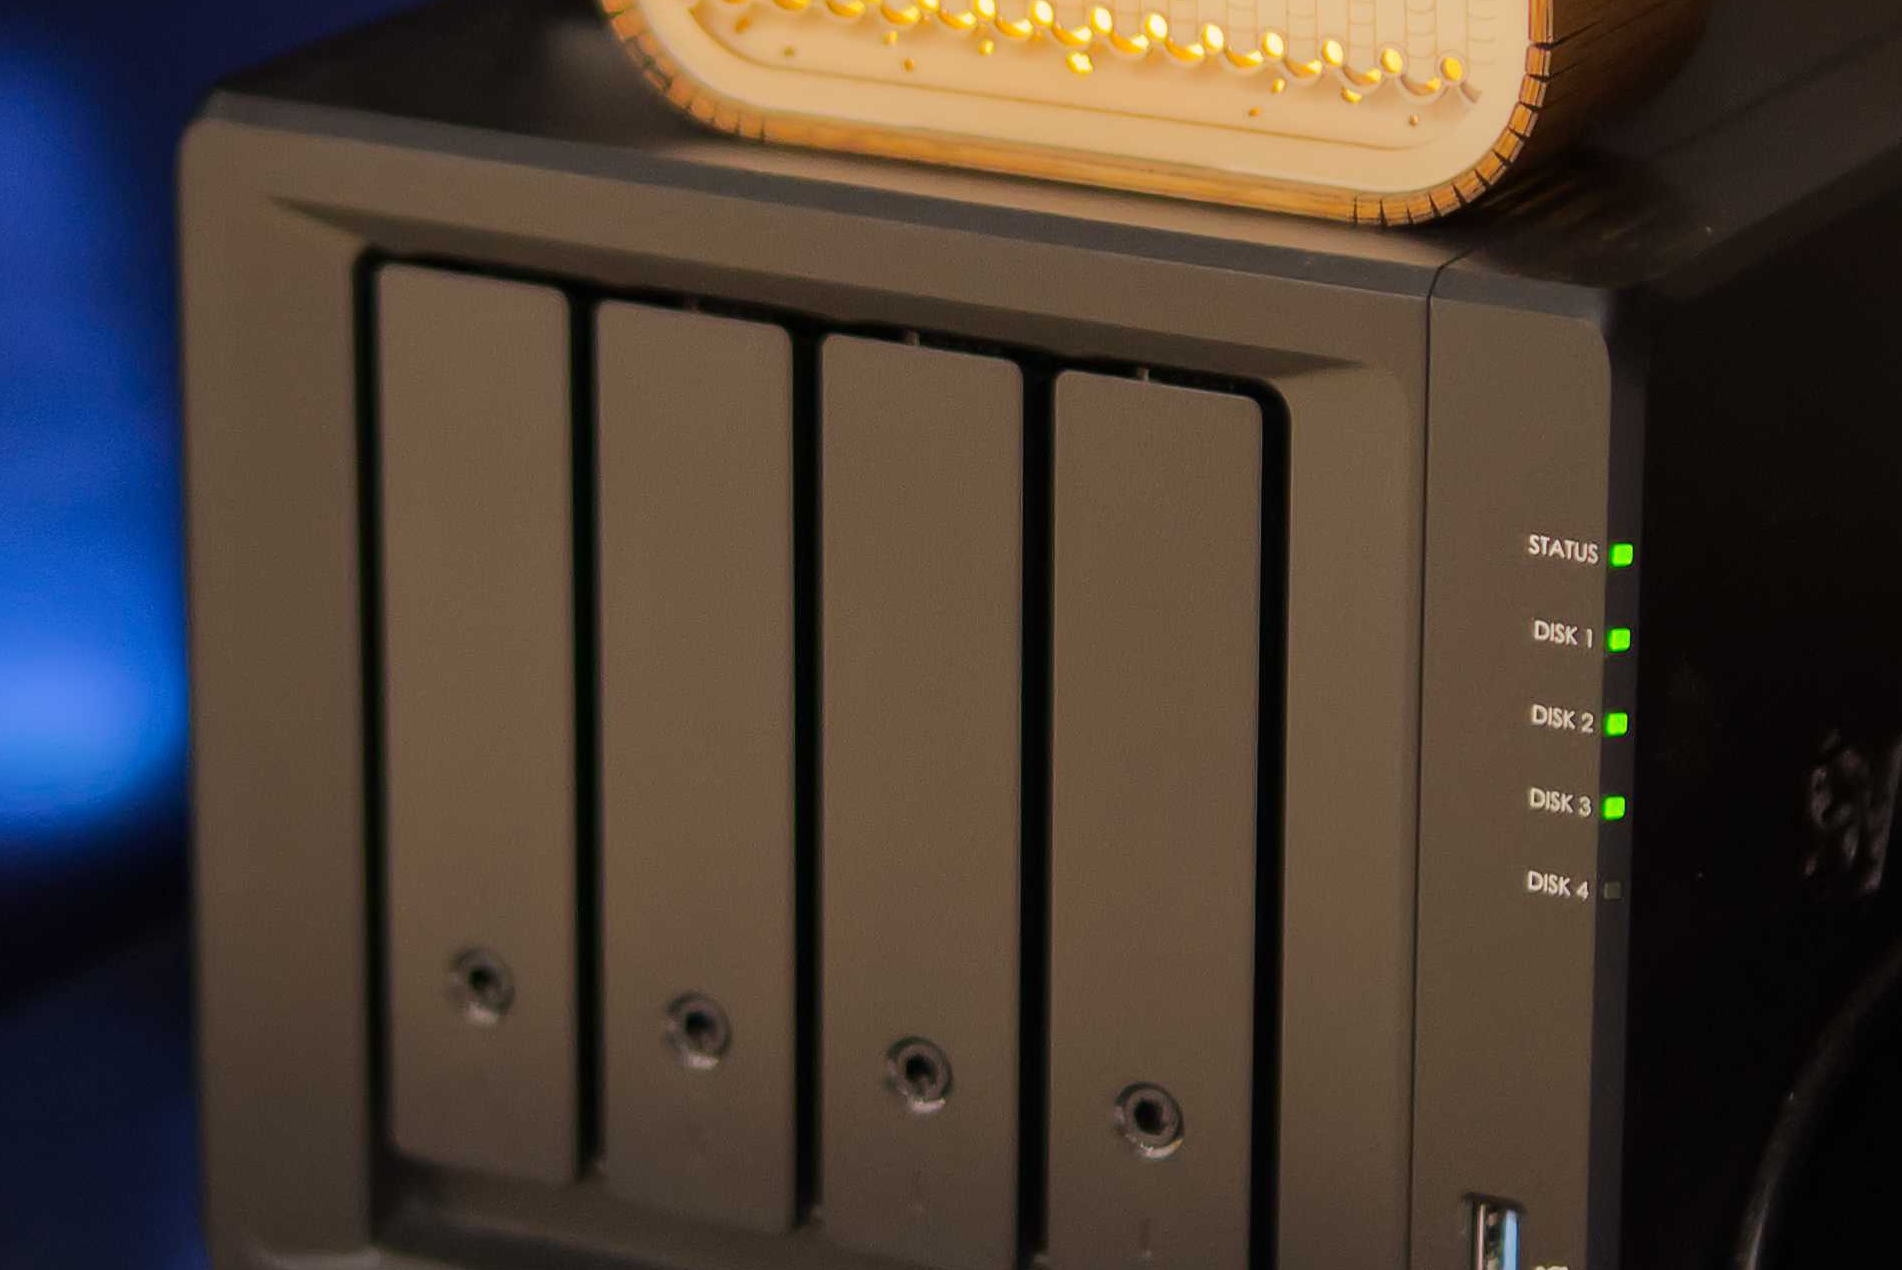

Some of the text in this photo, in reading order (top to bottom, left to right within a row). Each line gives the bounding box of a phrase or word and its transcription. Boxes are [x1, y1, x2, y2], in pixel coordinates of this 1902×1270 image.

[1527, 533, 1599, 565] STATUS
[1532, 619, 1594, 649] DISK 1
[1530, 703, 1595, 734] DISK 2
[1528, 787, 1592, 818] DISK 3
[1526, 870, 1590, 901] DISK 4
